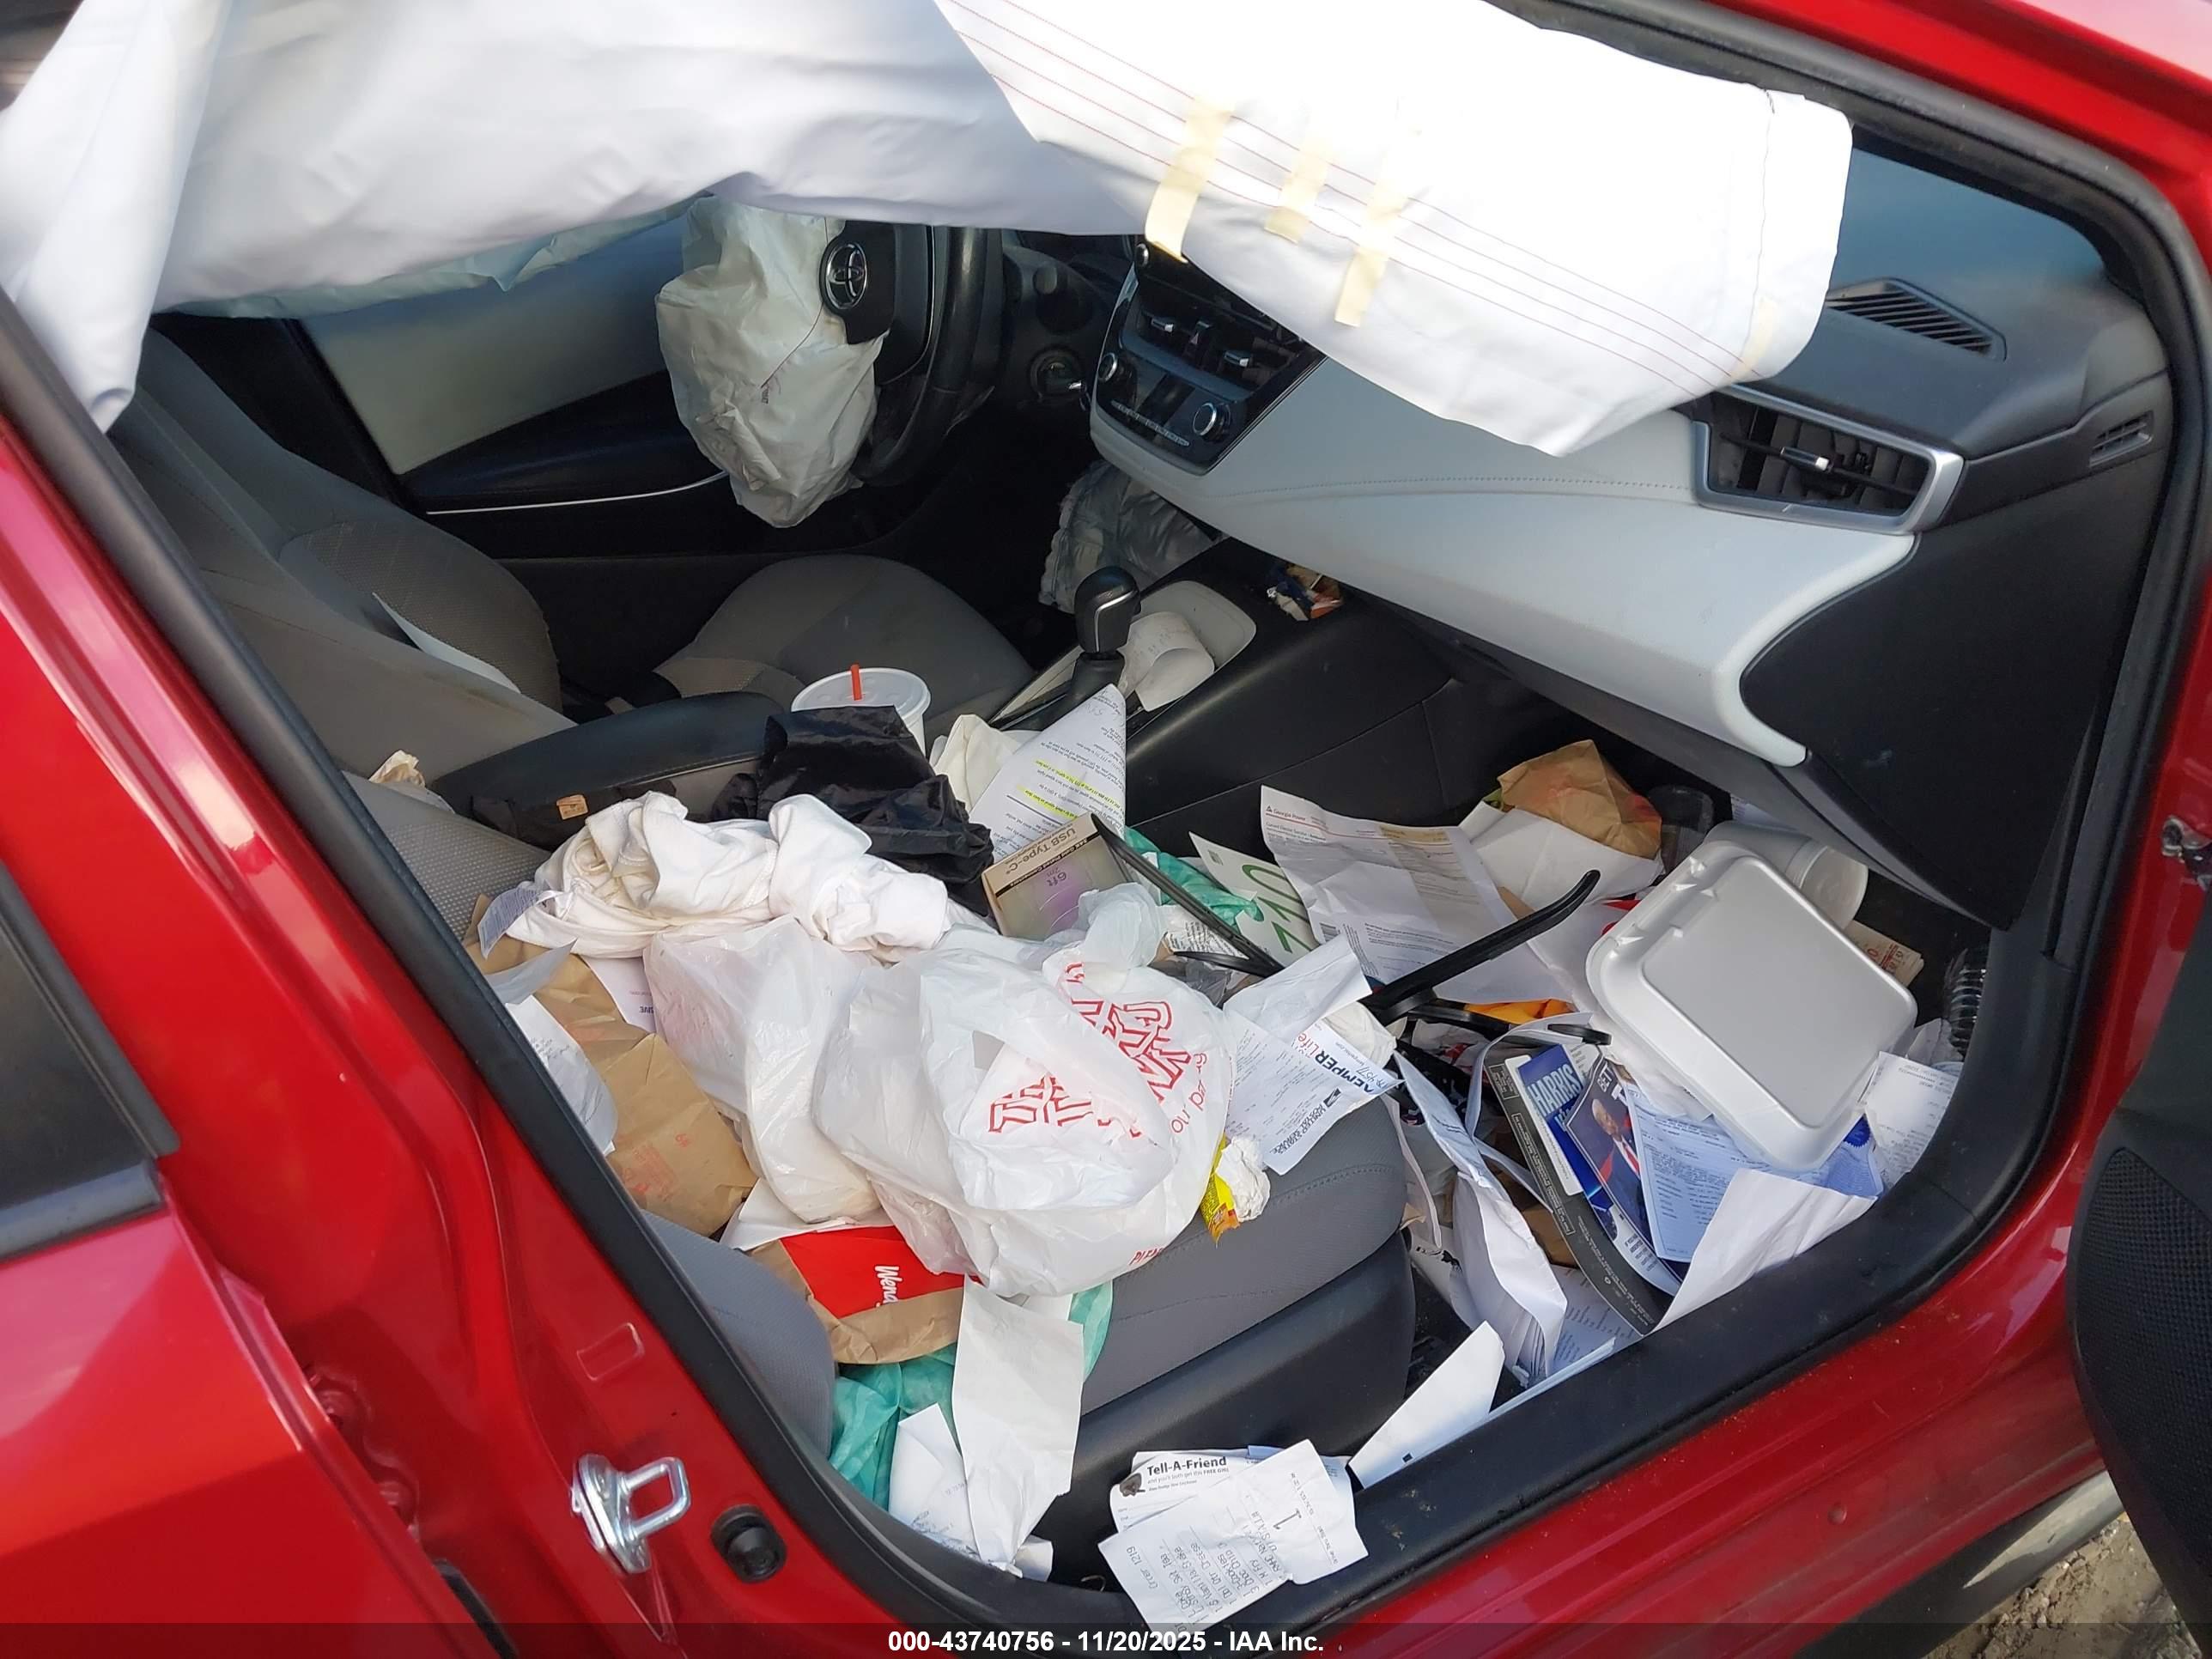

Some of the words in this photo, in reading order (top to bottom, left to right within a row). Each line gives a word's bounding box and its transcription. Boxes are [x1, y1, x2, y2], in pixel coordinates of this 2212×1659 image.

[1050, 827, 1076, 847] USB
[1046, 871, 1068, 888] 6ft
[1527, 1063, 1583, 1117] HARRIS
[1147, 1455, 1227, 1476] Tell-A-Friend
[1273, 1508, 1304, 1531] 1
[1126, 1545, 1143, 1565] 1219
